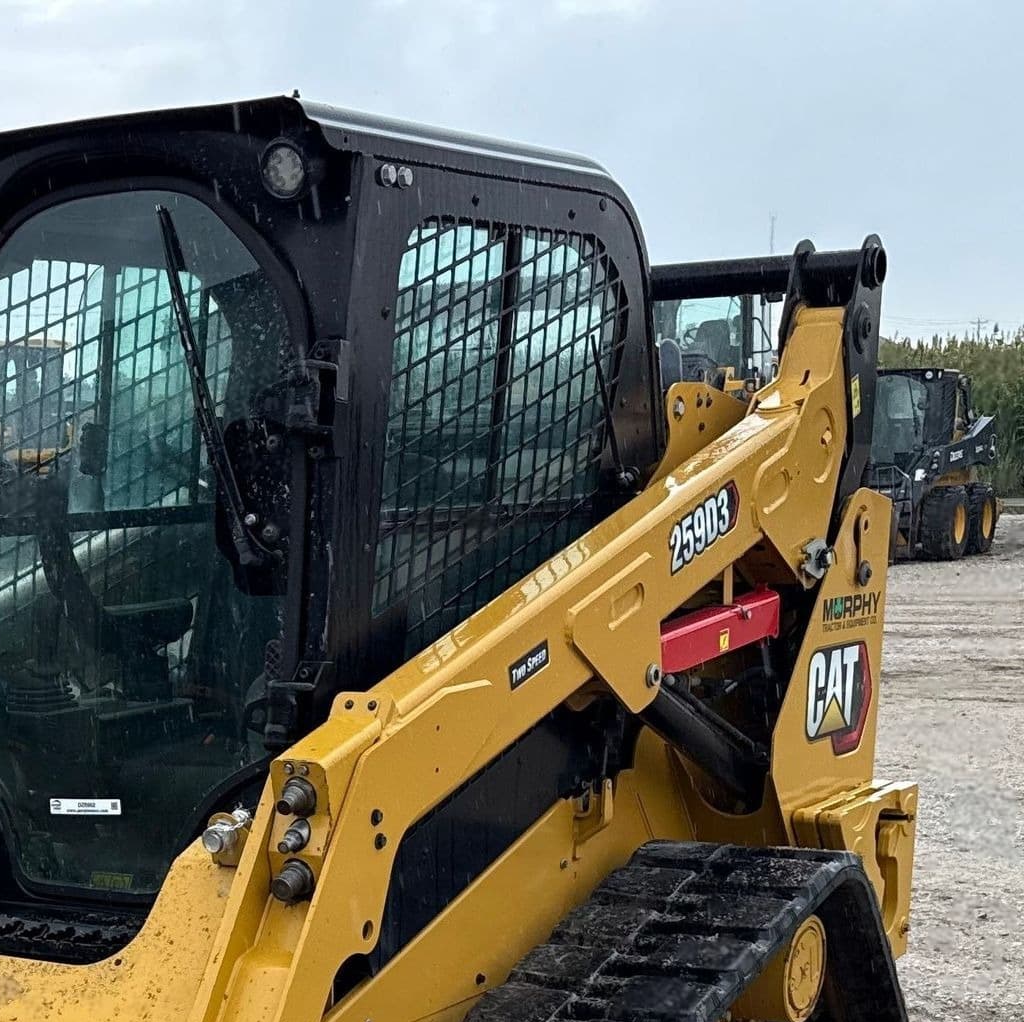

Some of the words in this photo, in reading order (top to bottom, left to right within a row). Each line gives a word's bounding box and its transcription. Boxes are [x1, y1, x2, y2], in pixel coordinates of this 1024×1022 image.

[669, 487, 731, 573] 259D3
[822, 590, 882, 622] MURPHY
[807, 644, 860, 738] CAT
